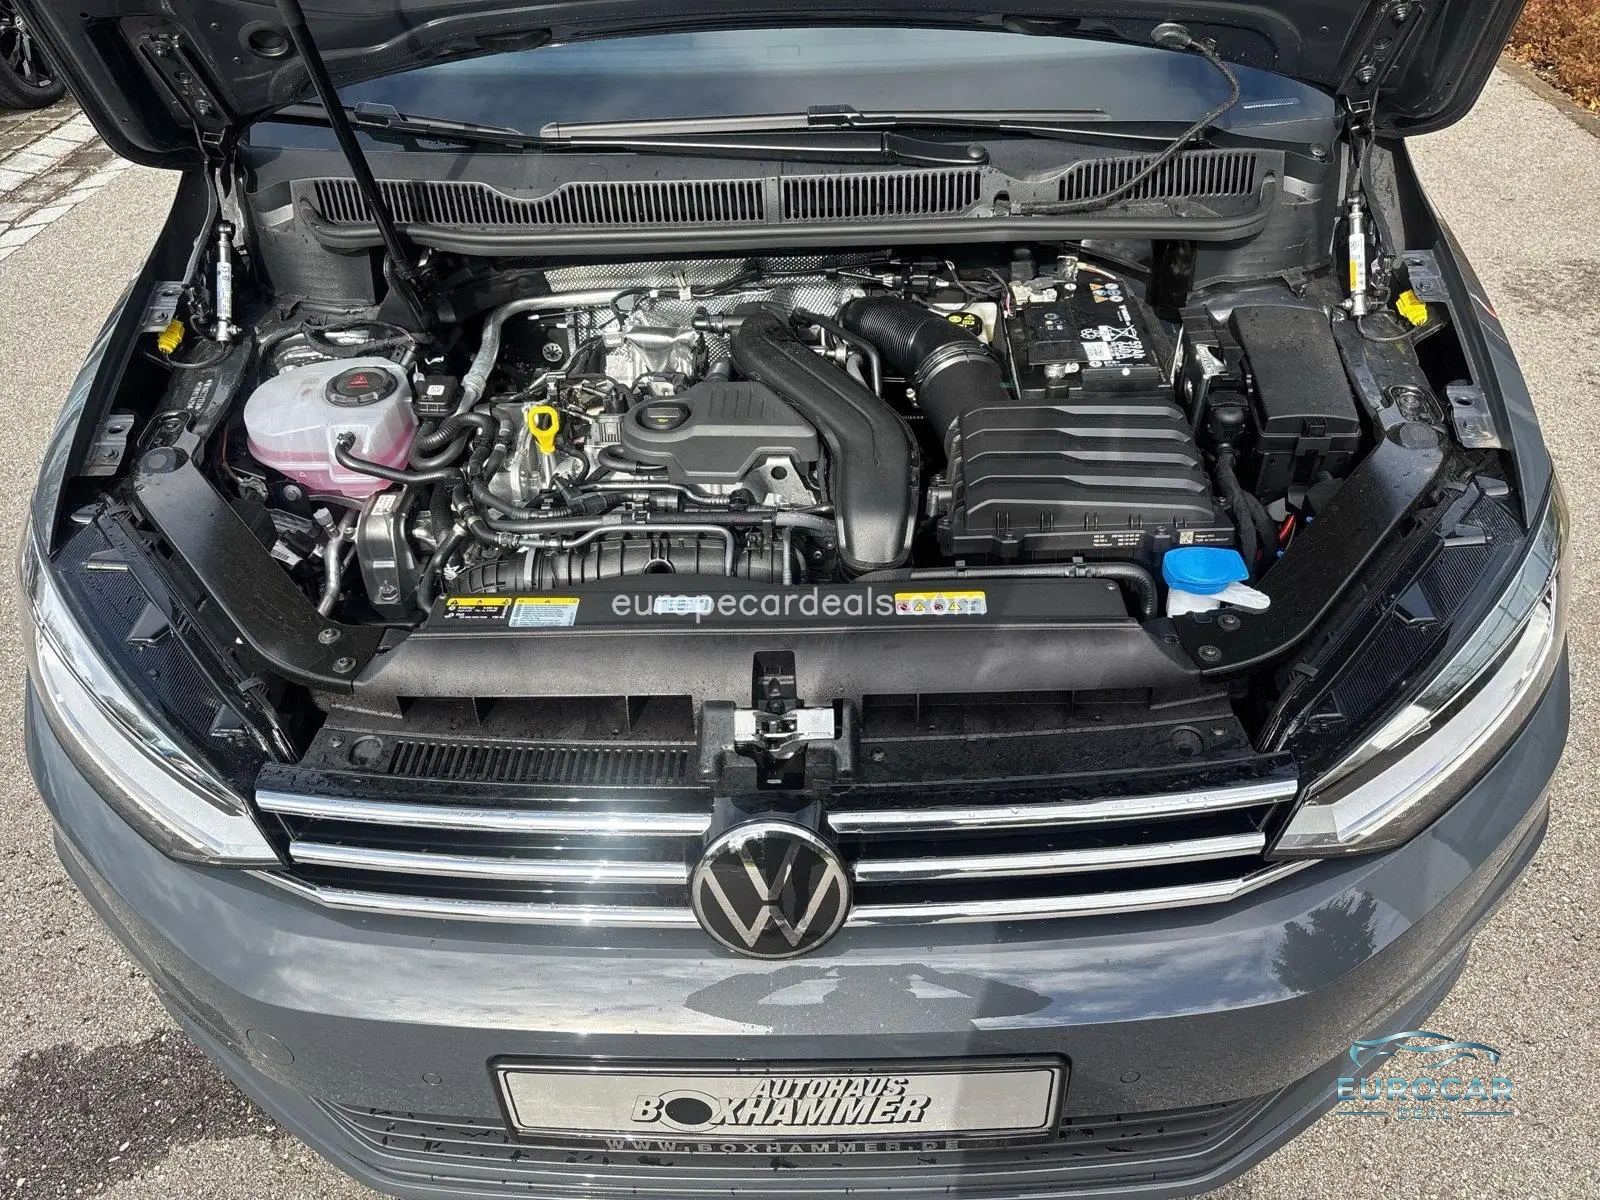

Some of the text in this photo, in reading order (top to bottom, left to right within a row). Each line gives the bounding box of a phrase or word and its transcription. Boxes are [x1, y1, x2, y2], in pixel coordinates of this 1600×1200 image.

[749, 1076, 910, 1099] AUTOHAUS
[631, 1090, 932, 1131] BOXHAMMER
[606, 1138, 959, 1154] WWW.BOXHAMMER.DE
